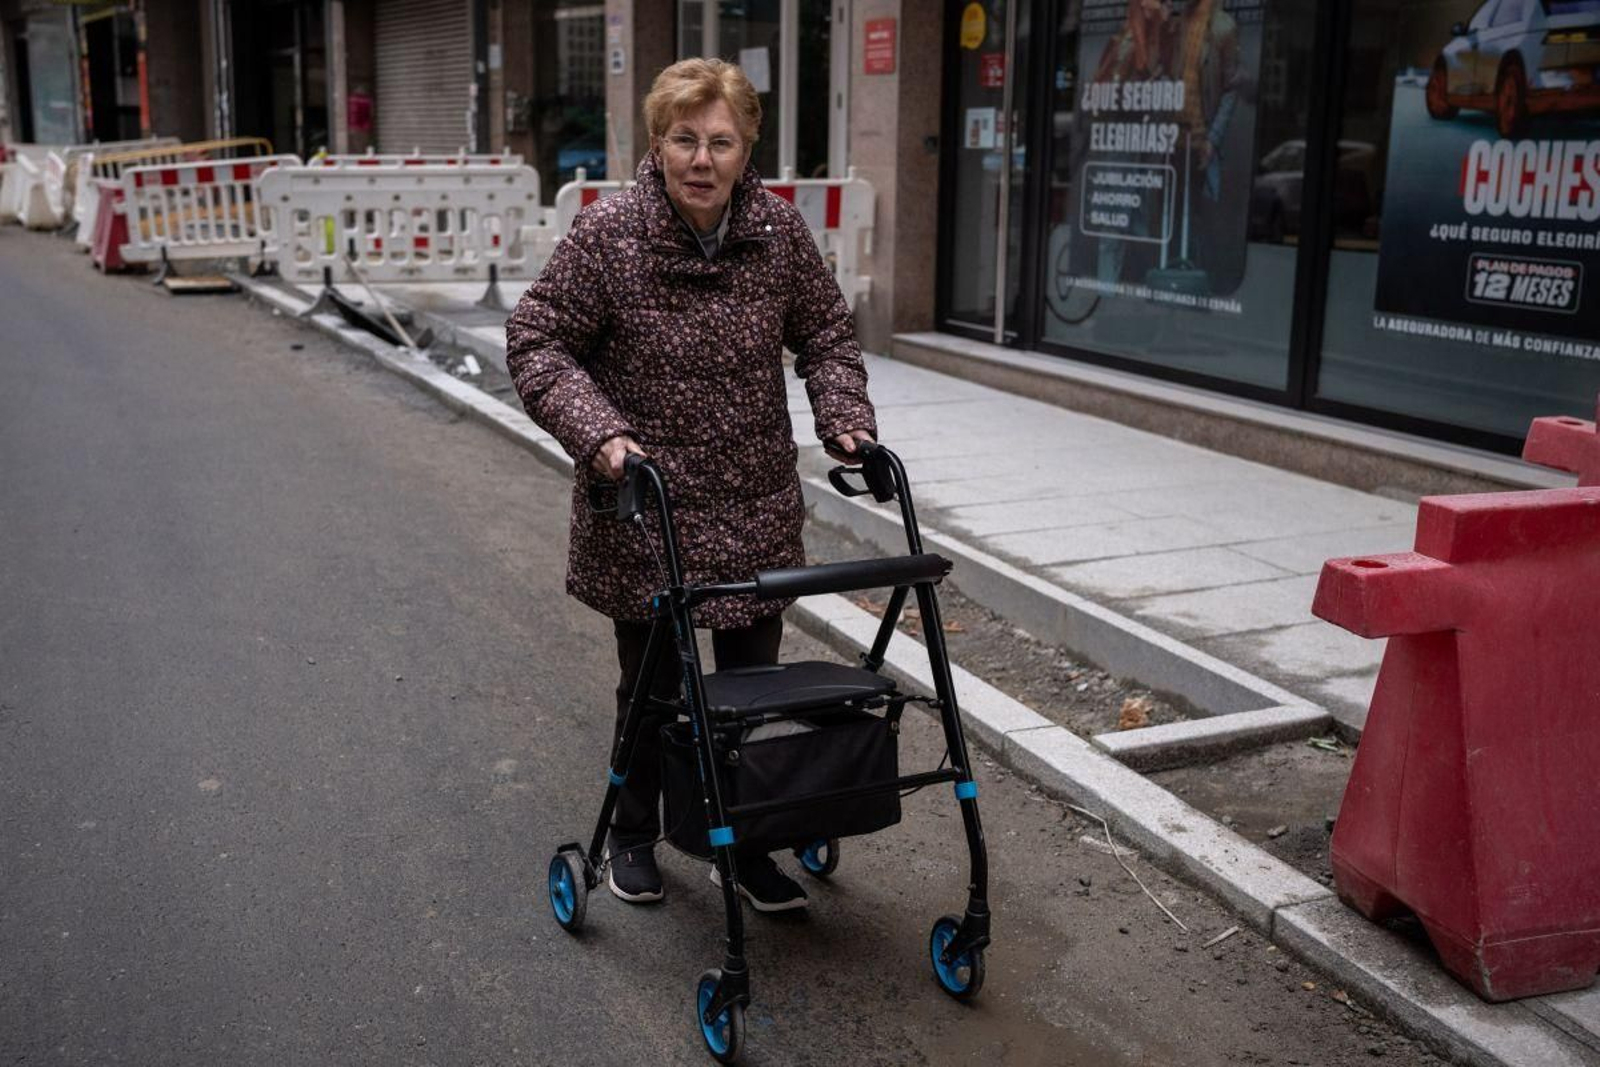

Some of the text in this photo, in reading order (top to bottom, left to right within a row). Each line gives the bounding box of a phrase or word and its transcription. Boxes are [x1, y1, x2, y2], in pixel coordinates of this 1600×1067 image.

[1122, 80, 1185, 111] SEGURO
[1090, 116, 1179, 153] ELEGIRÍAS?
[1091, 171, 1163, 188] JUBILACIÓN
[1464, 139, 1600, 222] COCHES
[1091, 192, 1141, 208] AHORRO
[1090, 211, 1129, 227] SALUD
[1430, 221, 1468, 241] ¿QUÉ
[1470, 226, 1533, 245] SEGURO
[1476, 259, 1575, 278] PLAN DE PAGOS
[1473, 271, 1575, 307] 12 MESES
[1373, 316, 1600, 361] LA ASEGURADORA DE MÁS CONFIANZA
